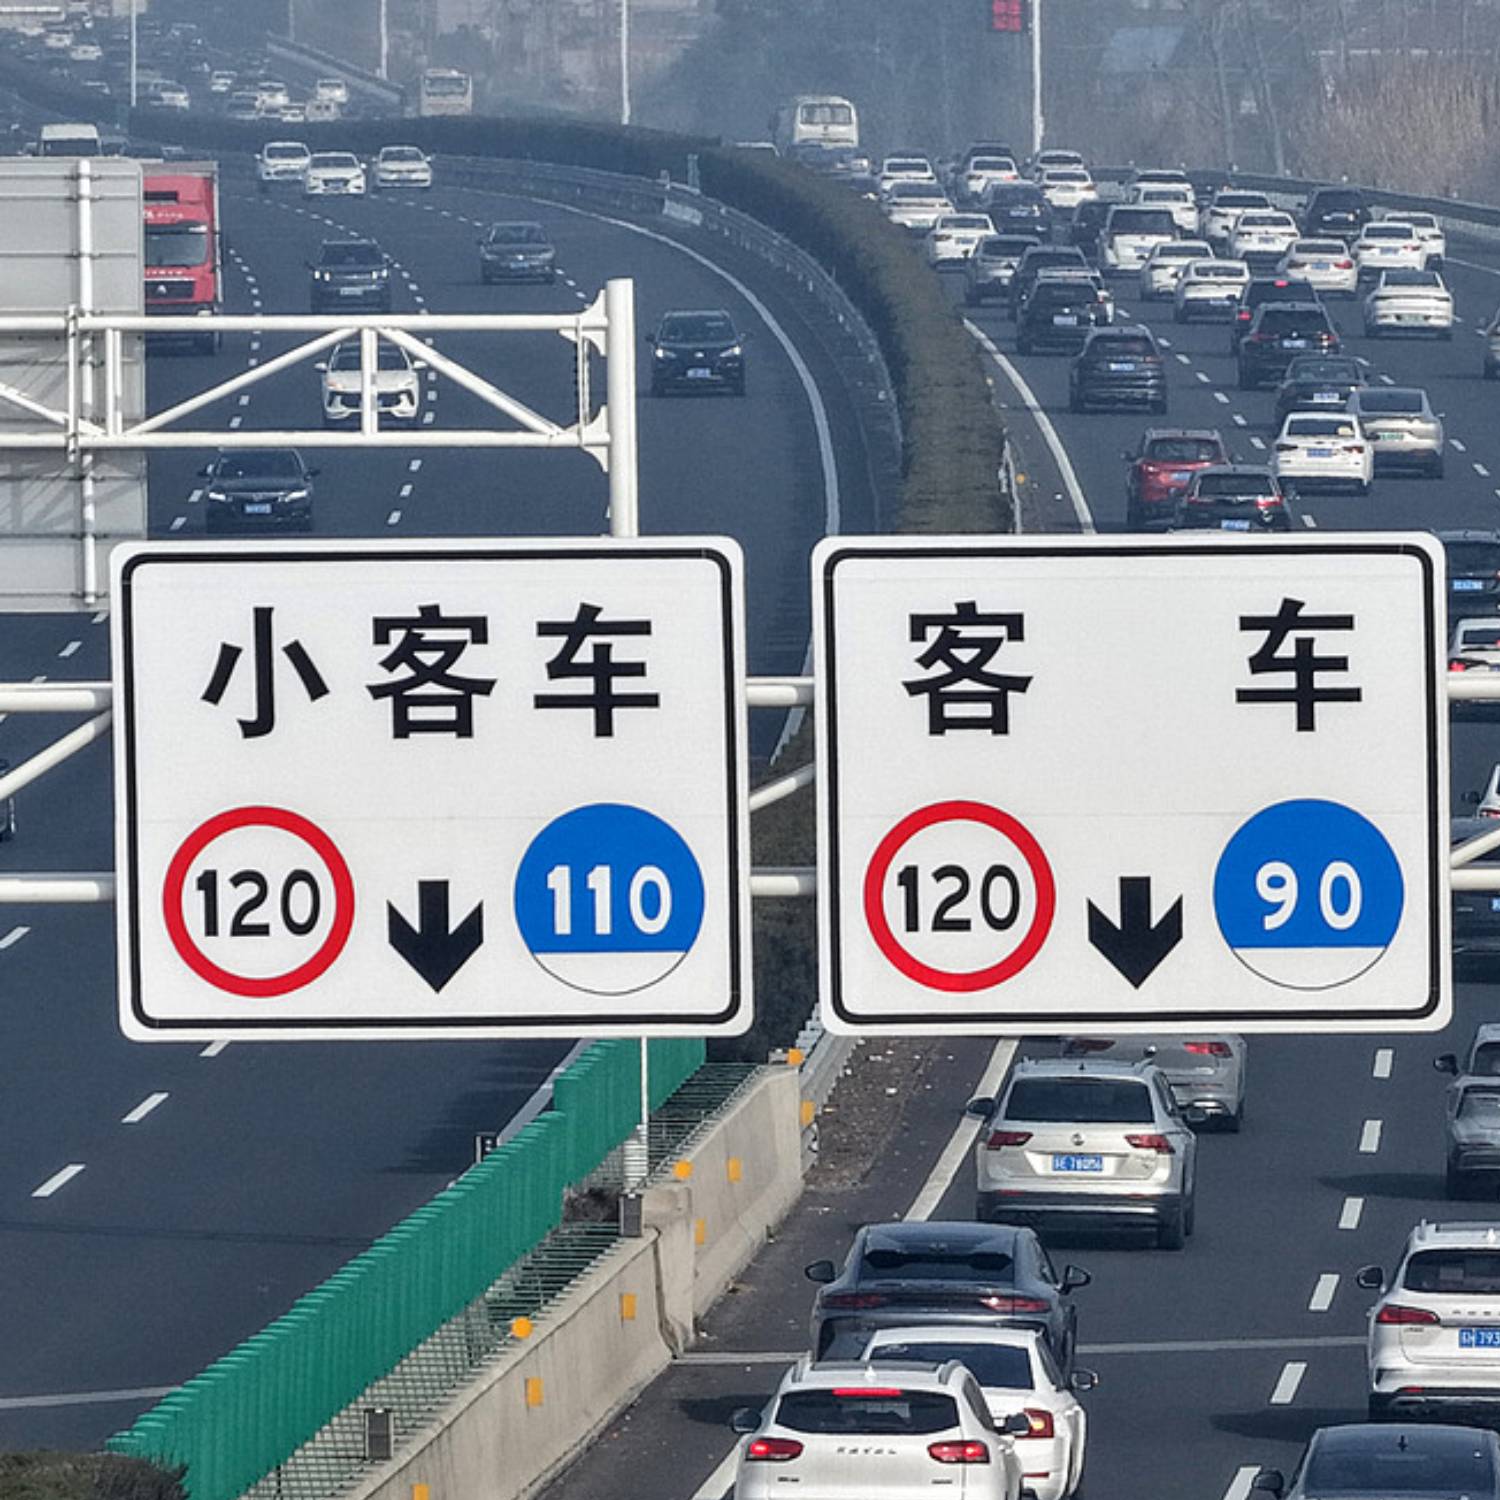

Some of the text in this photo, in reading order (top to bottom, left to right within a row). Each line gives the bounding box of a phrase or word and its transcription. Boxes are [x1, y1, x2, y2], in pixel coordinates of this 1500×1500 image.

[201, 602, 661, 739] 小客车
[196, 868, 320, 937] 120
[547, 864, 673, 936] 110
[897, 864, 1020, 932] 120
[1255, 860, 1362, 931] 90
